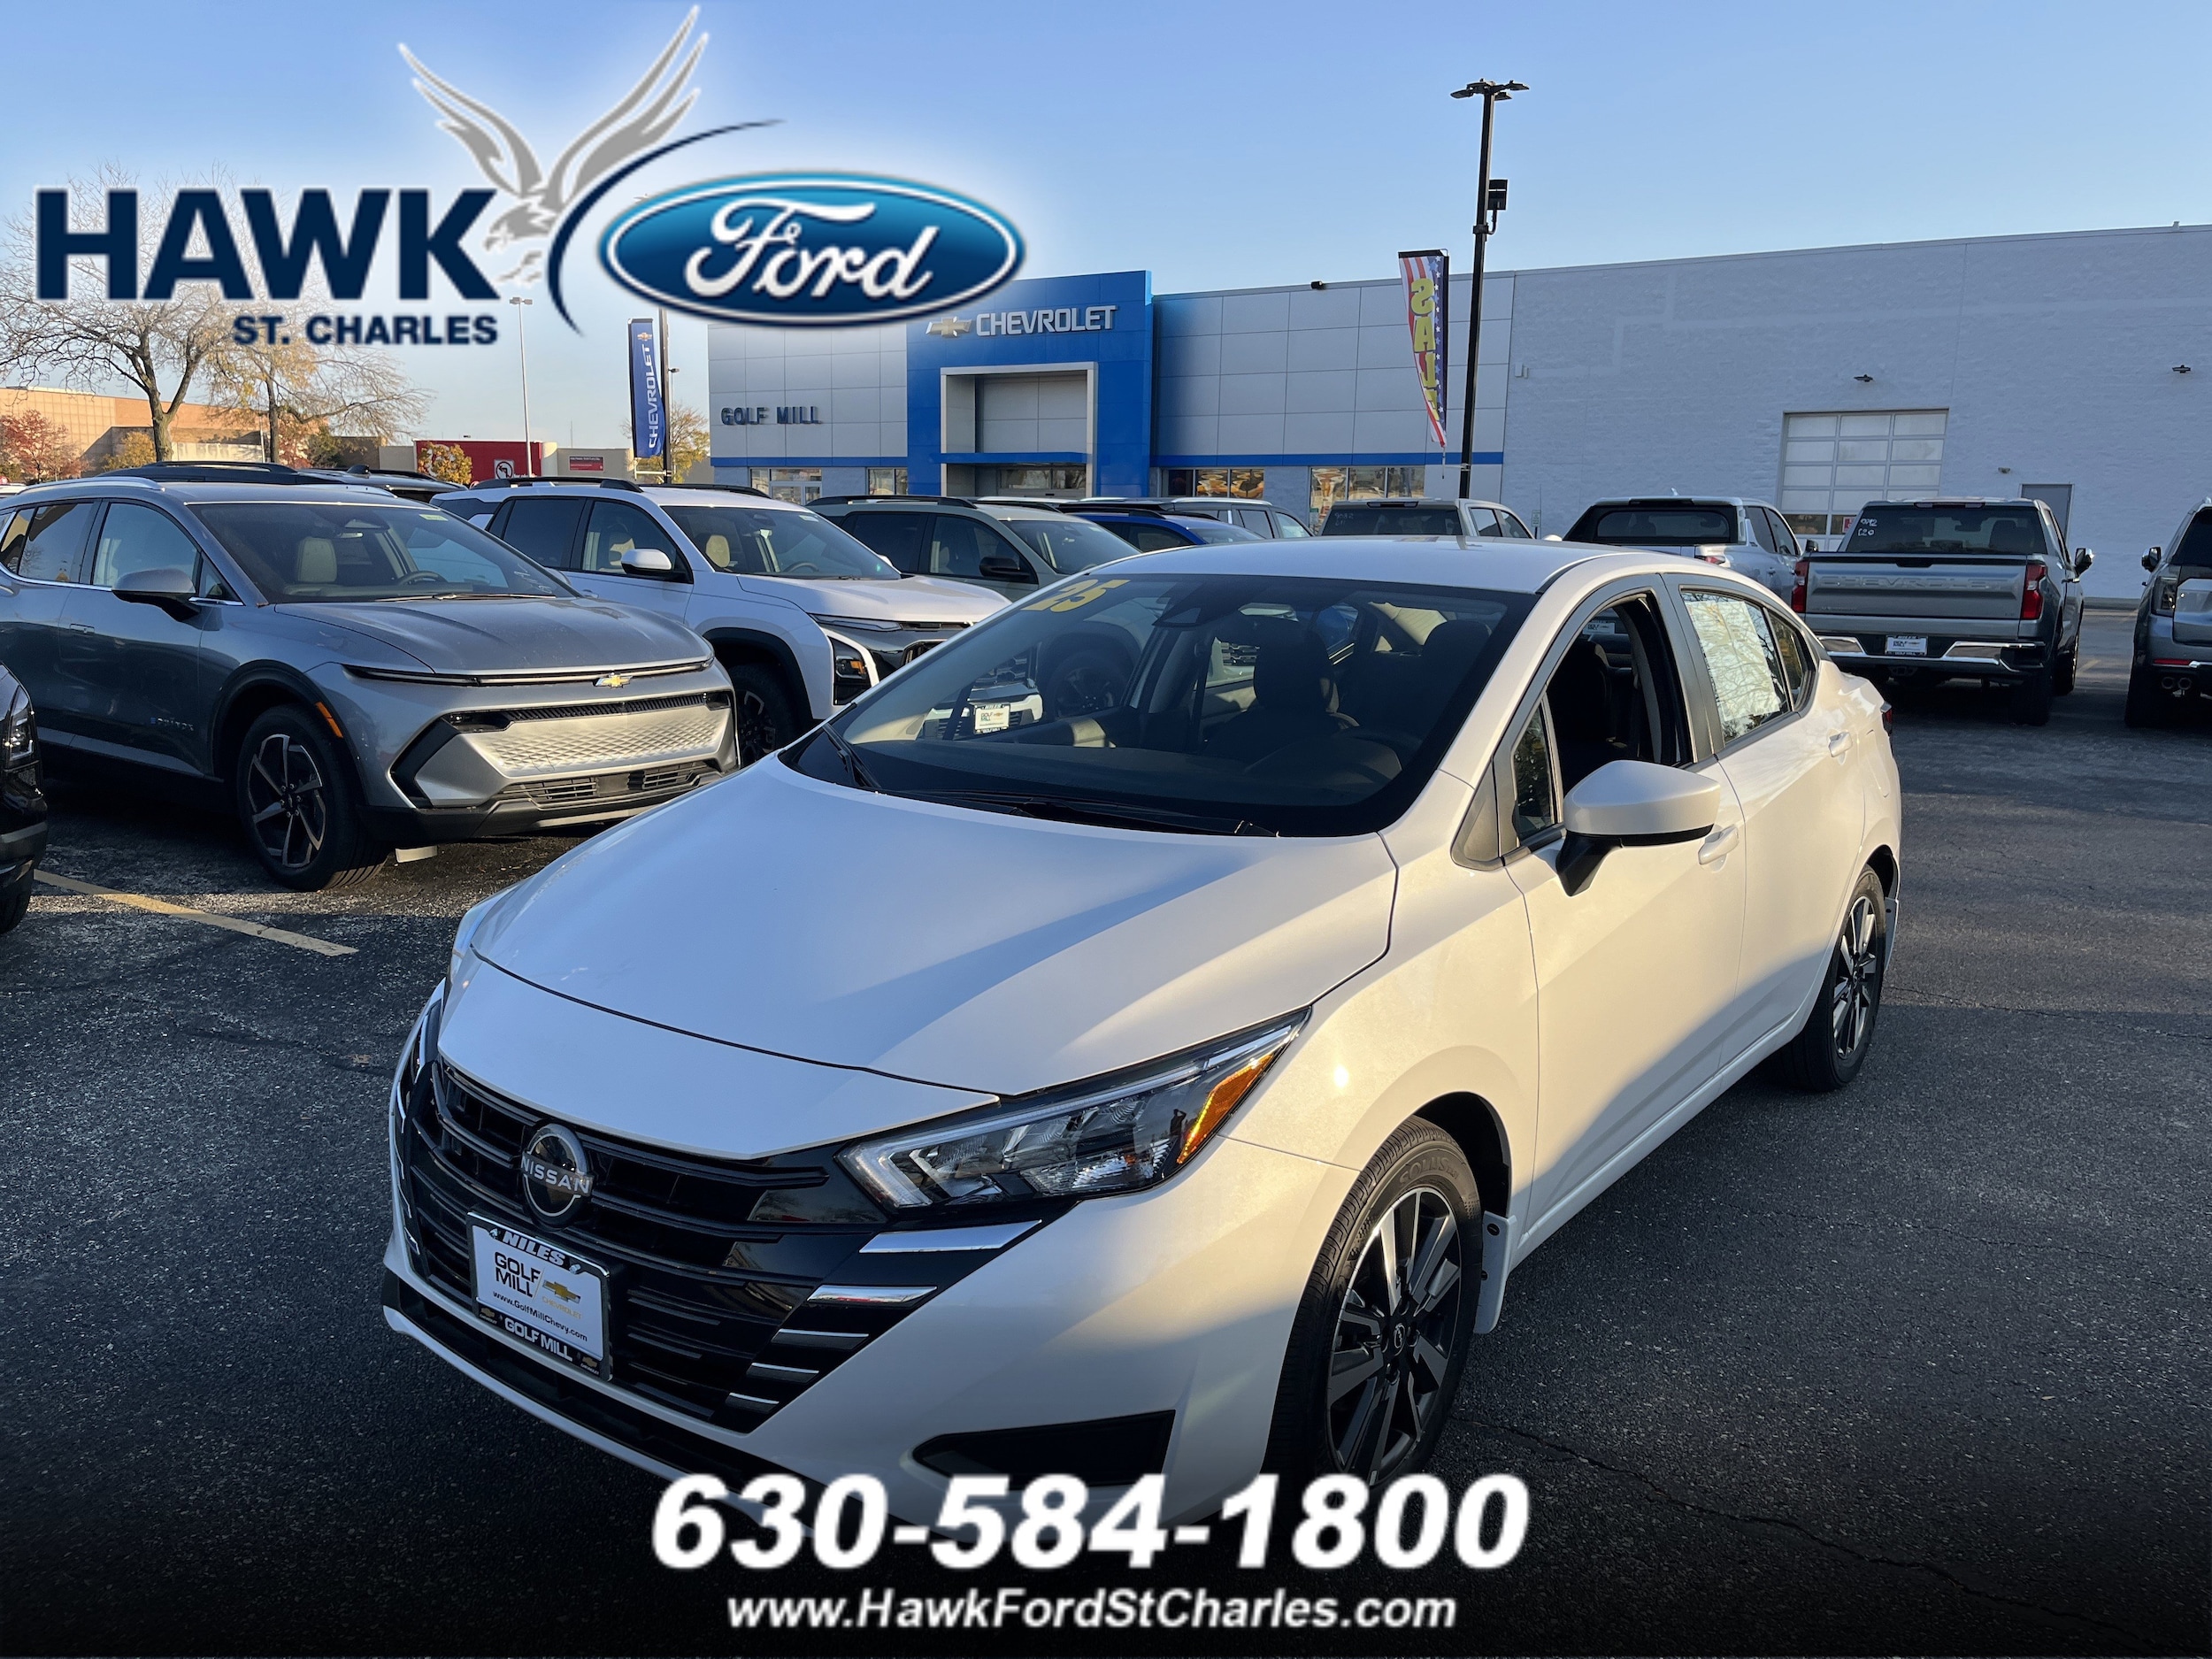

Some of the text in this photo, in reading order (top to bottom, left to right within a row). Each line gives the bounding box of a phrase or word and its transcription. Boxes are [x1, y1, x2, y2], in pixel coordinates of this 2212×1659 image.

[976, 305, 1117, 336] CHEVROLET
[642, 344, 659, 449] CHEVROLET
[721, 406, 822, 425] GOLF MILL
[1020, 580, 1131, 612] 25
[521, 1156, 589, 1194] NISSAN
[503, 1231, 565, 1265] NILES
[495, 1252, 541, 1283] GOLF
[495, 1267, 533, 1298] MILL
[493, 1291, 588, 1342] www.GolfMillChevy.com
[542, 1296, 581, 1319] CHEVROLET
[504, 1317, 573, 1362] GOLF MILL
